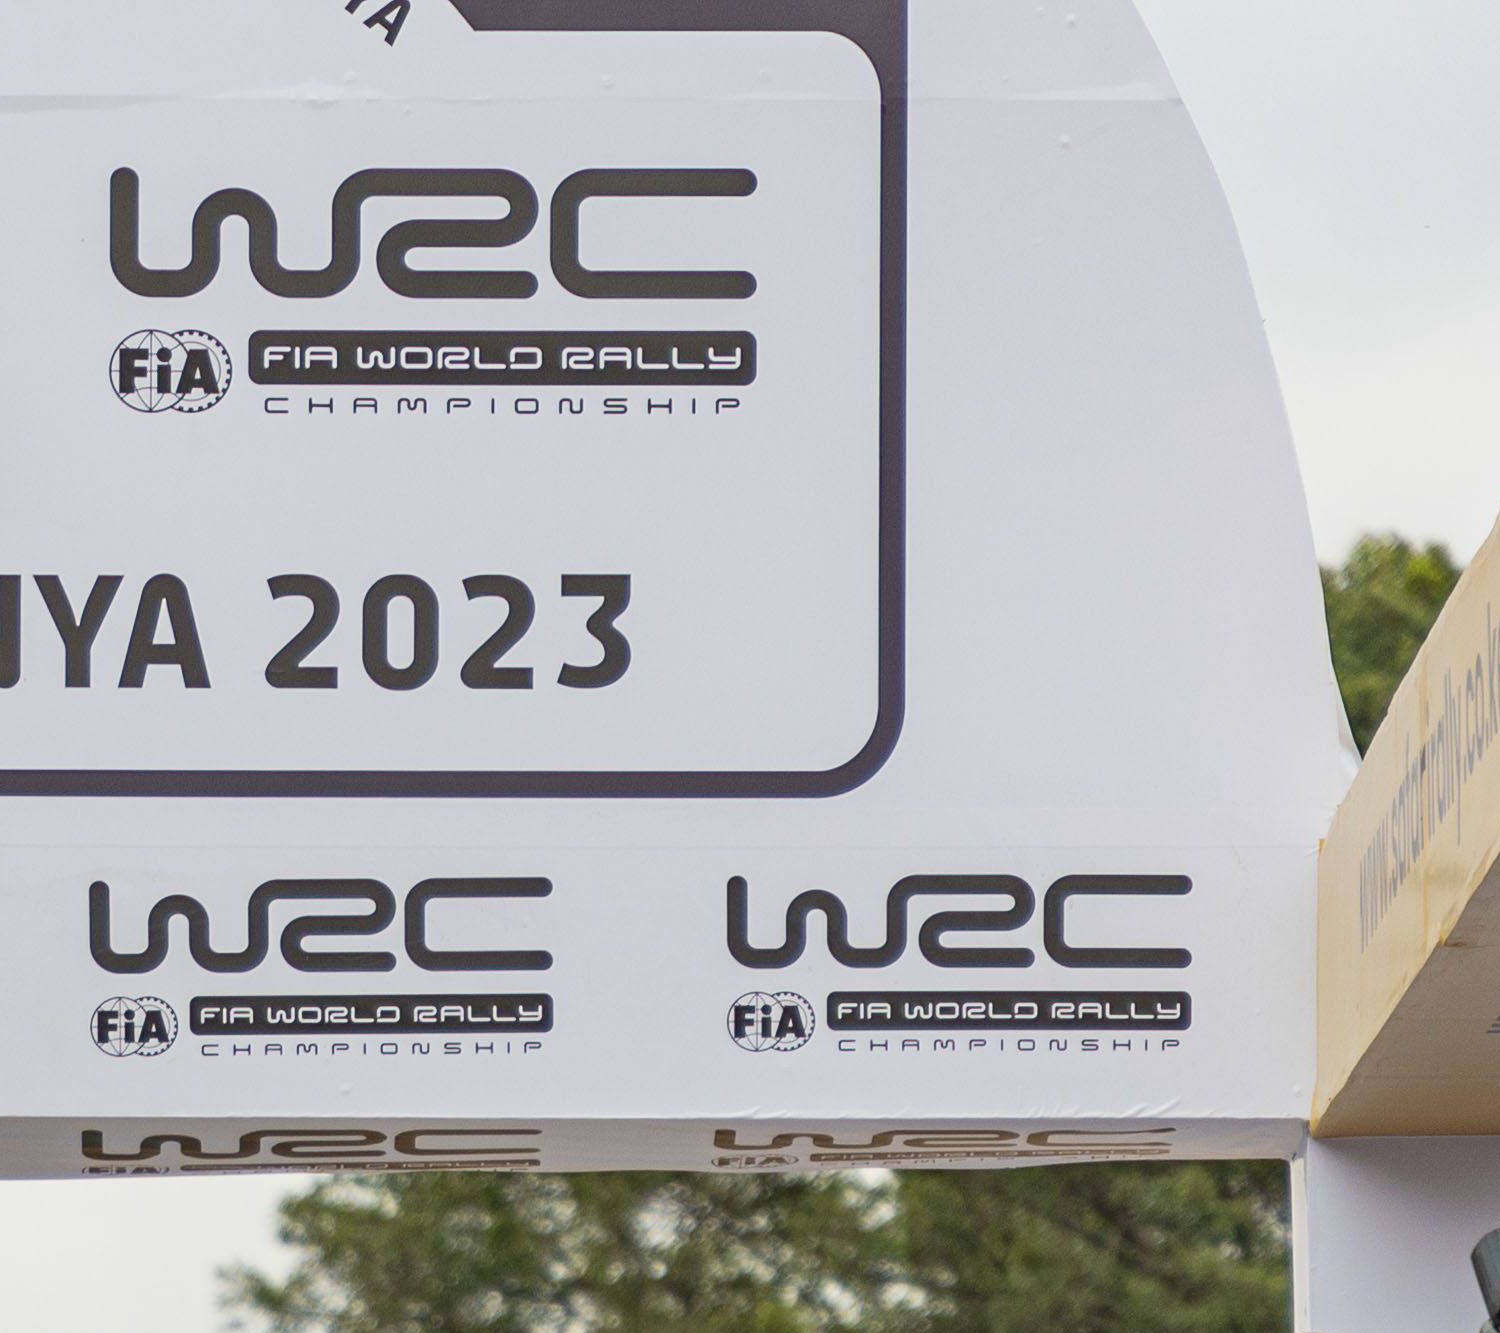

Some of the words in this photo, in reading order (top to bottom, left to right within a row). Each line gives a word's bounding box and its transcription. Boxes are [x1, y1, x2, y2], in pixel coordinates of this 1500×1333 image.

[110, 167, 757, 299] WRC
[264, 346, 337, 369] FIA
[357, 347, 542, 369] WORLD
[562, 347, 741, 369] RALLY
[265, 398, 740, 414] CHAMPIONSHIP
[265, 574, 631, 690] 2023
[89, 877, 553, 974] WRC
[727, 875, 1192, 969] WRC
[838, 1003, 891, 1019] FIA
[905, 1003, 1038, 1019] WORLD
[1052, 1003, 1180, 1019] RALLY
[838, 1039, 1179, 1051] CHAMPIONSHIP
